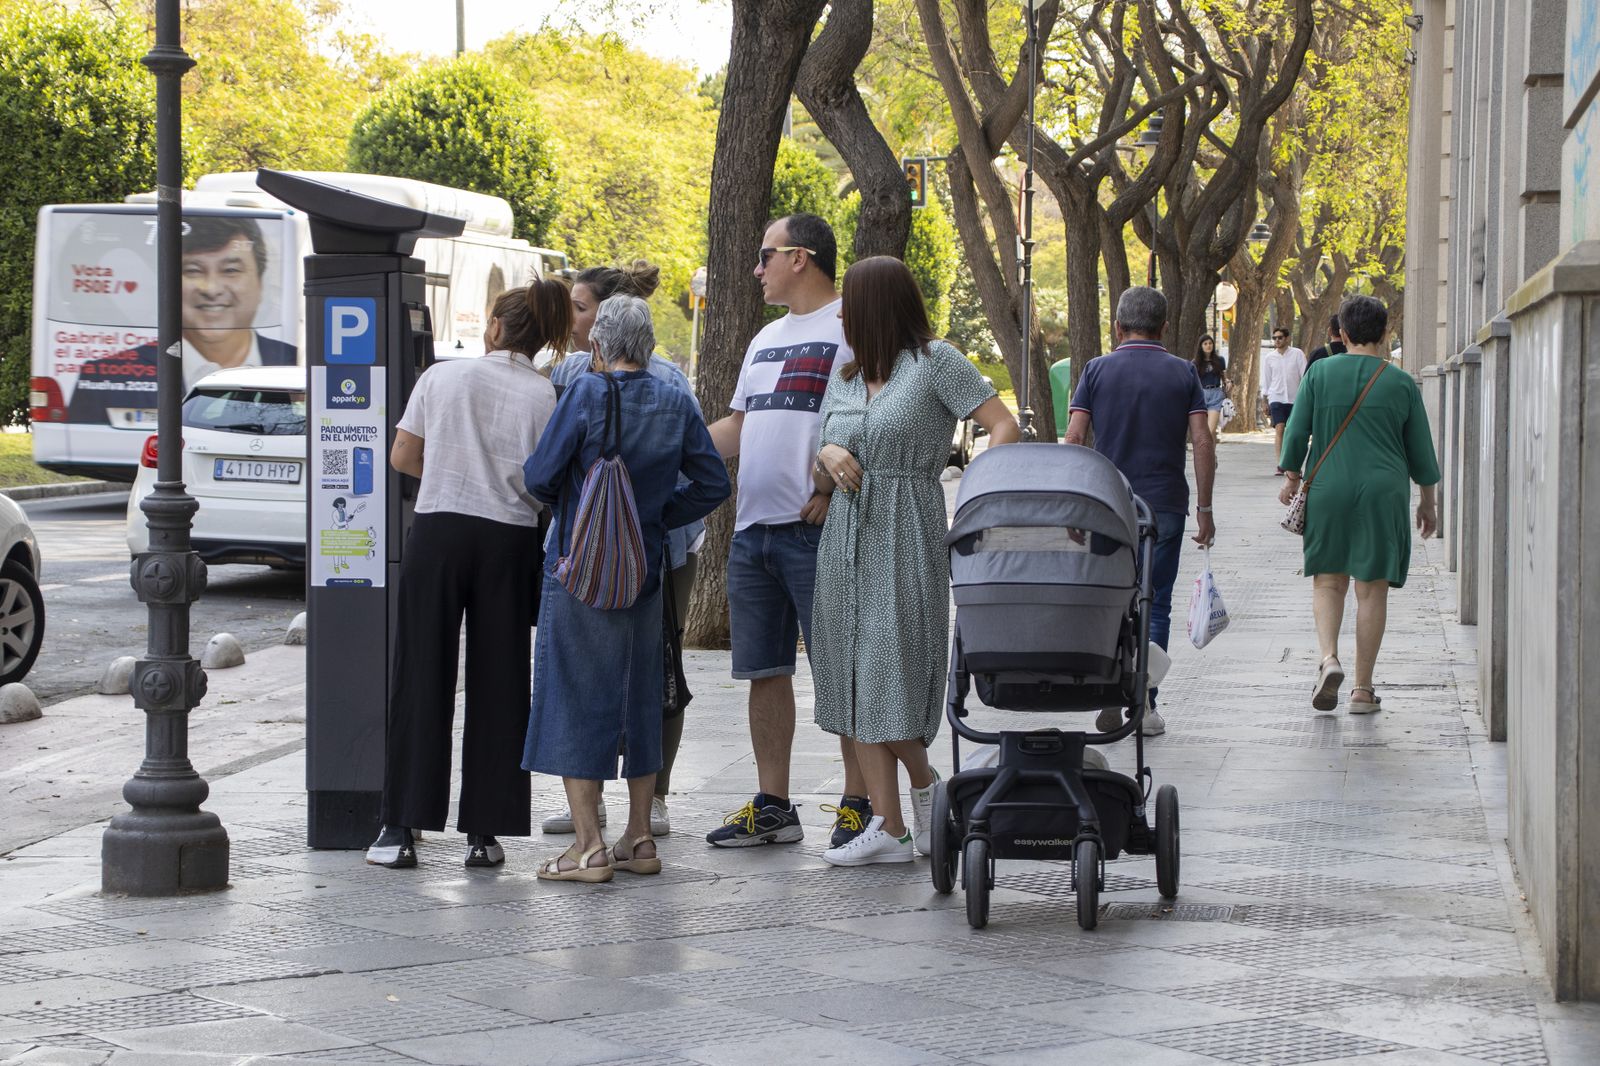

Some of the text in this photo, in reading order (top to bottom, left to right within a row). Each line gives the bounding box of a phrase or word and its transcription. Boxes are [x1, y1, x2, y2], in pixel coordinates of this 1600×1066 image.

[71, 264, 113, 276] Vota
[72, 279, 111, 293] PSOE
[55, 330, 119, 344] Gabriel
[331, 306, 369, 355] P
[55, 345, 138, 360] el alcalde
[755, 345, 830, 359] TOMMY
[55, 363, 96, 376] para
[78, 379, 158, 391] Huelva 2023
[320, 423, 378, 434] PARQUÍMETRO
[320, 434, 331, 442] EN
[333, 434, 342, 442] EL
[226, 462, 296, 478] 4110 HYP
